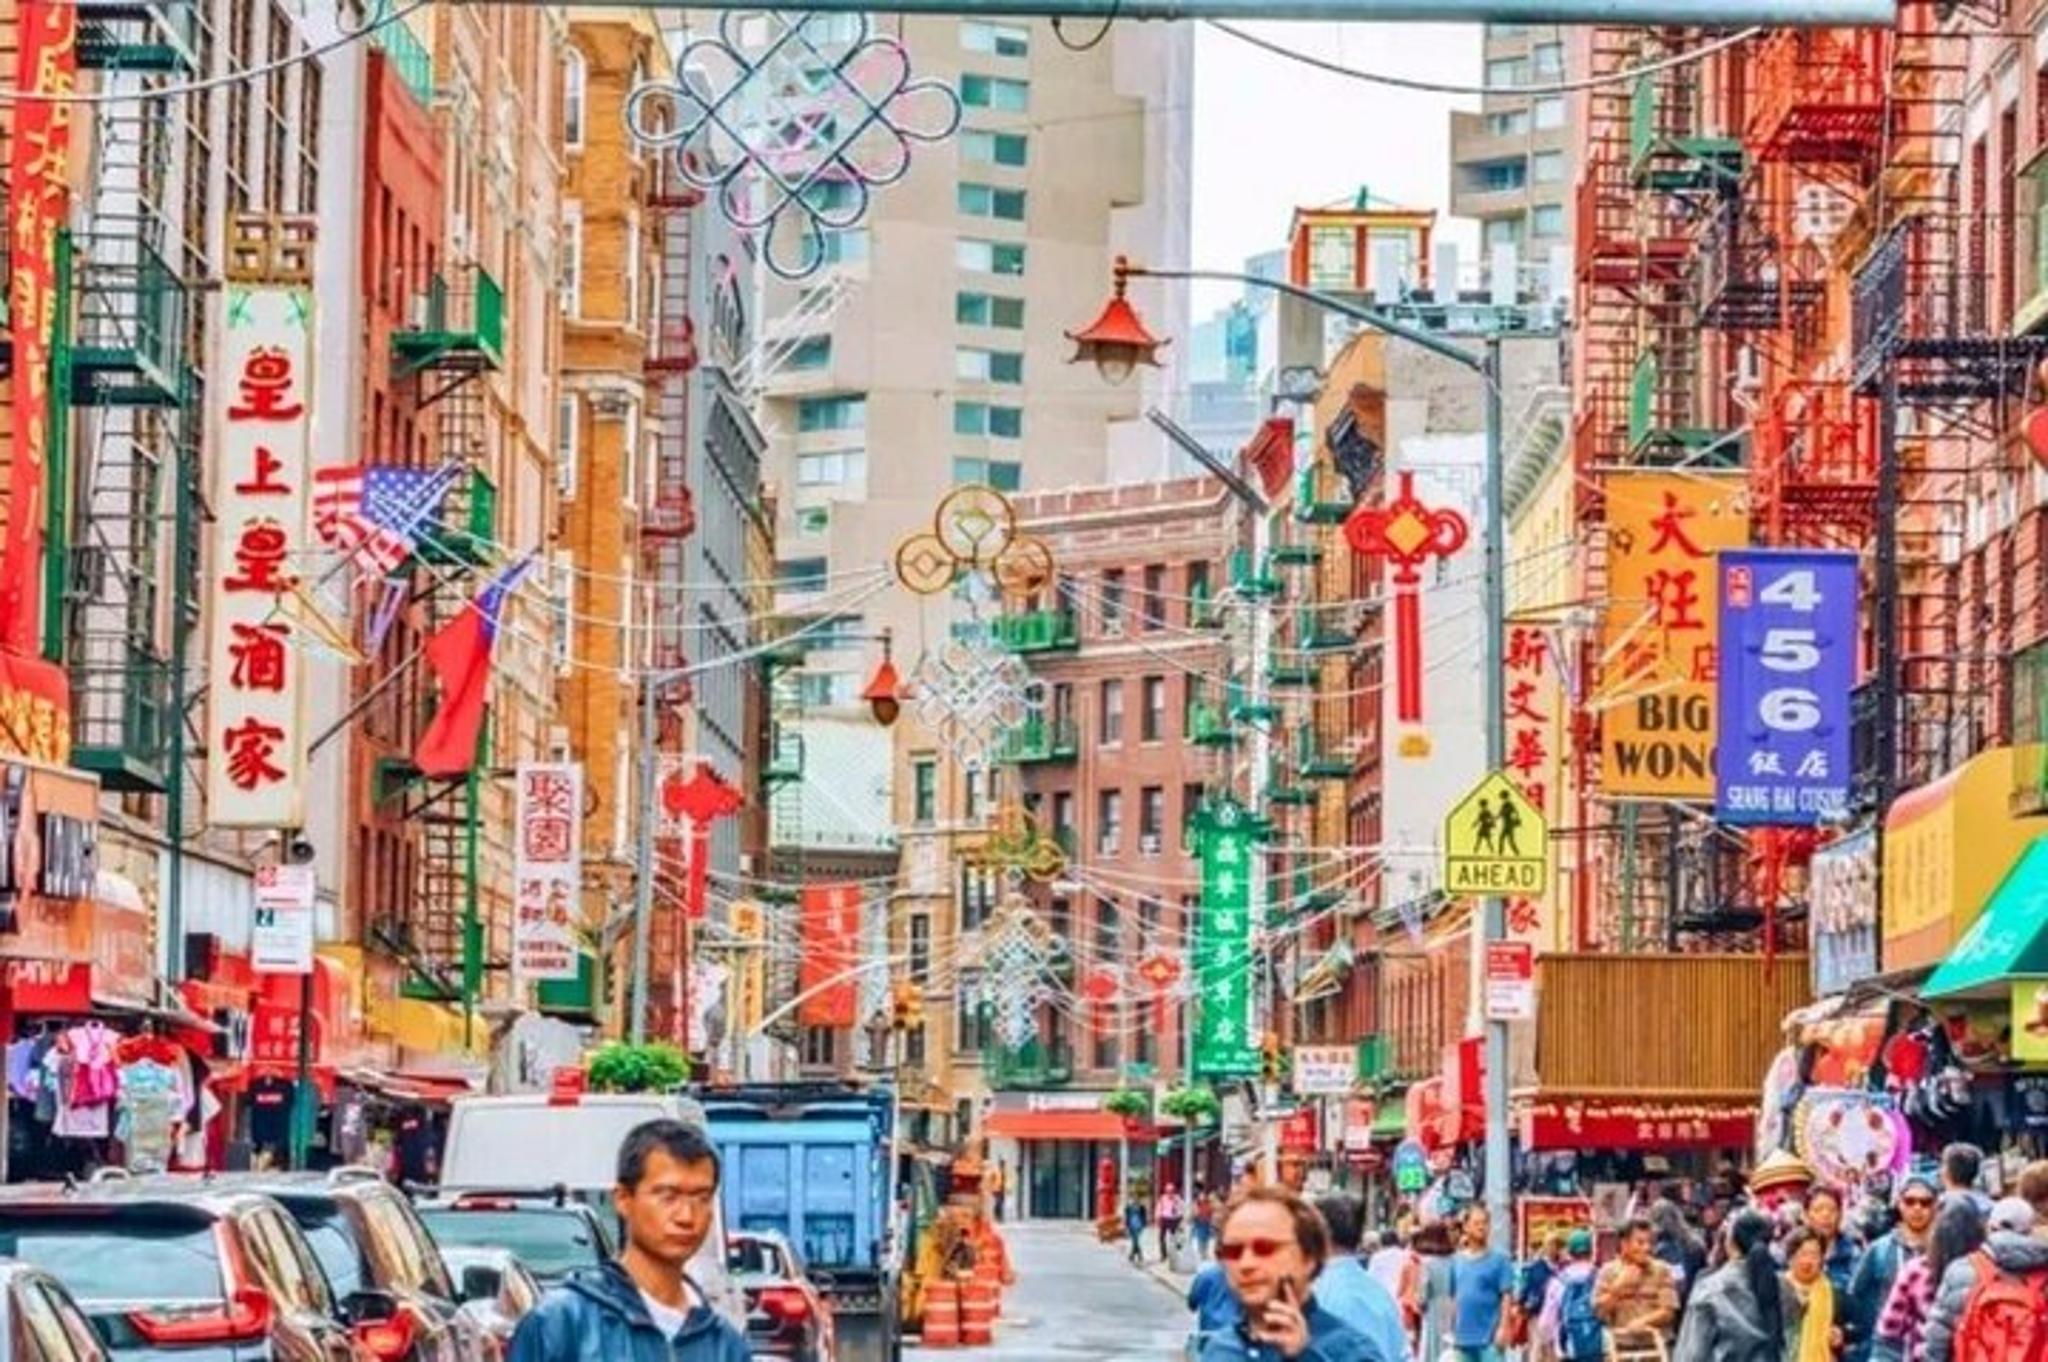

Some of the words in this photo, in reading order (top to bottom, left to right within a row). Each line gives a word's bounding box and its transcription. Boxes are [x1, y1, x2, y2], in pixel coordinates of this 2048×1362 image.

[223, 346, 304, 792] 皇上皇酒家
[1646, 490, 1713, 630] 大旺
[1638, 693, 1709, 732] BIG
[1615, 741, 1718, 780] WON
[1457, 864, 1535, 887] AHEAD
